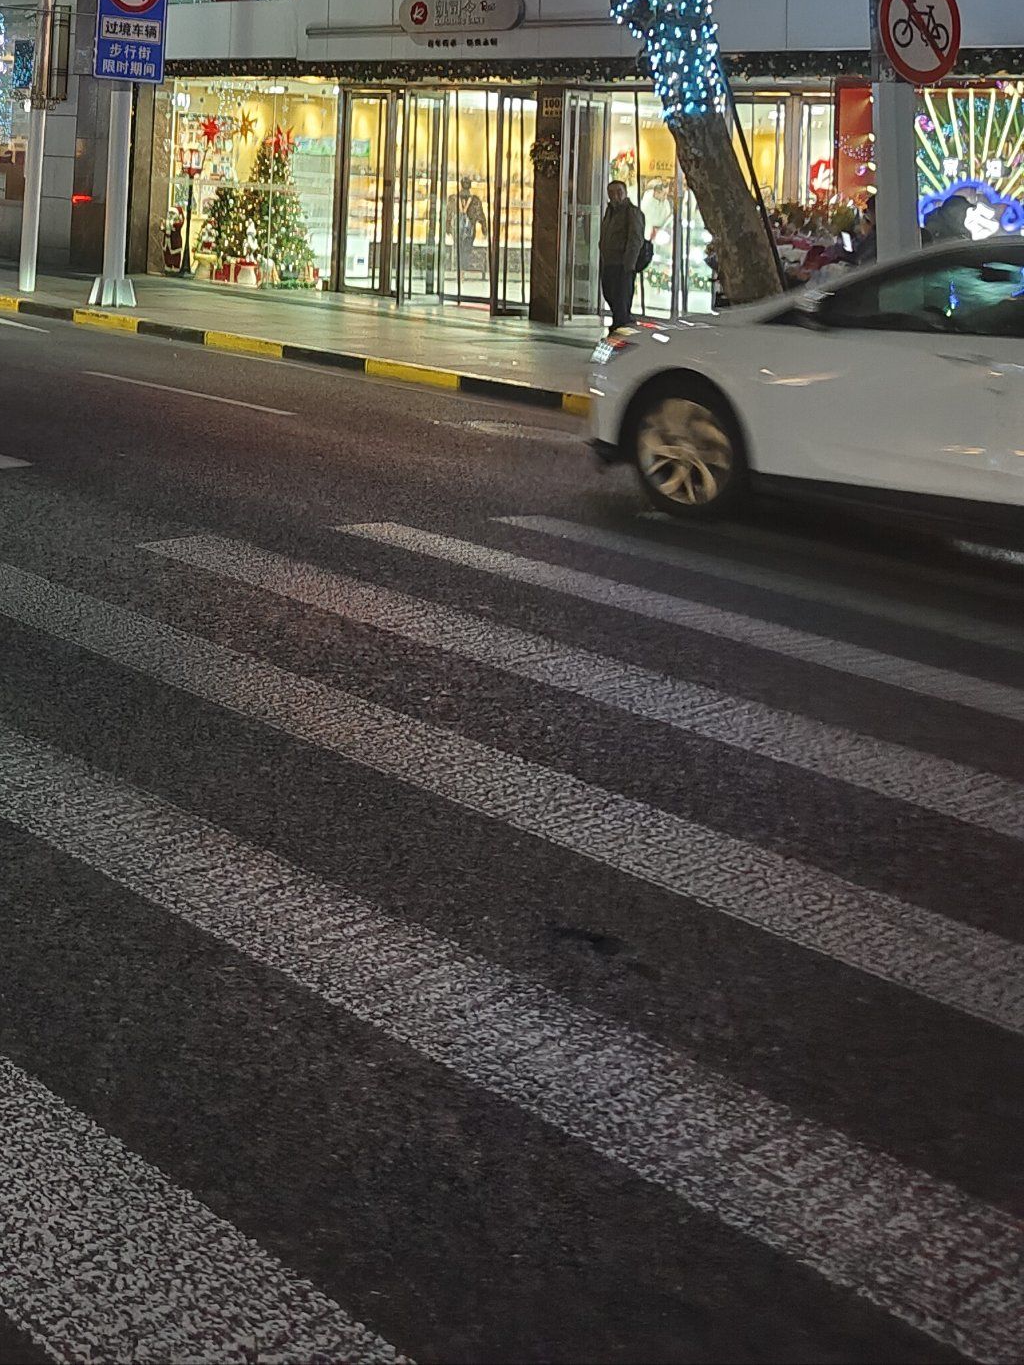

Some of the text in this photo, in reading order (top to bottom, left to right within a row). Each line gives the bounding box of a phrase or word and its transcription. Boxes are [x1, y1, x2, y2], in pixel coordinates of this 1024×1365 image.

[105, 21, 158, 39] 过境车辆
[109, 43, 152, 61] 步行街
[103, 59, 156, 77] 限时期间
